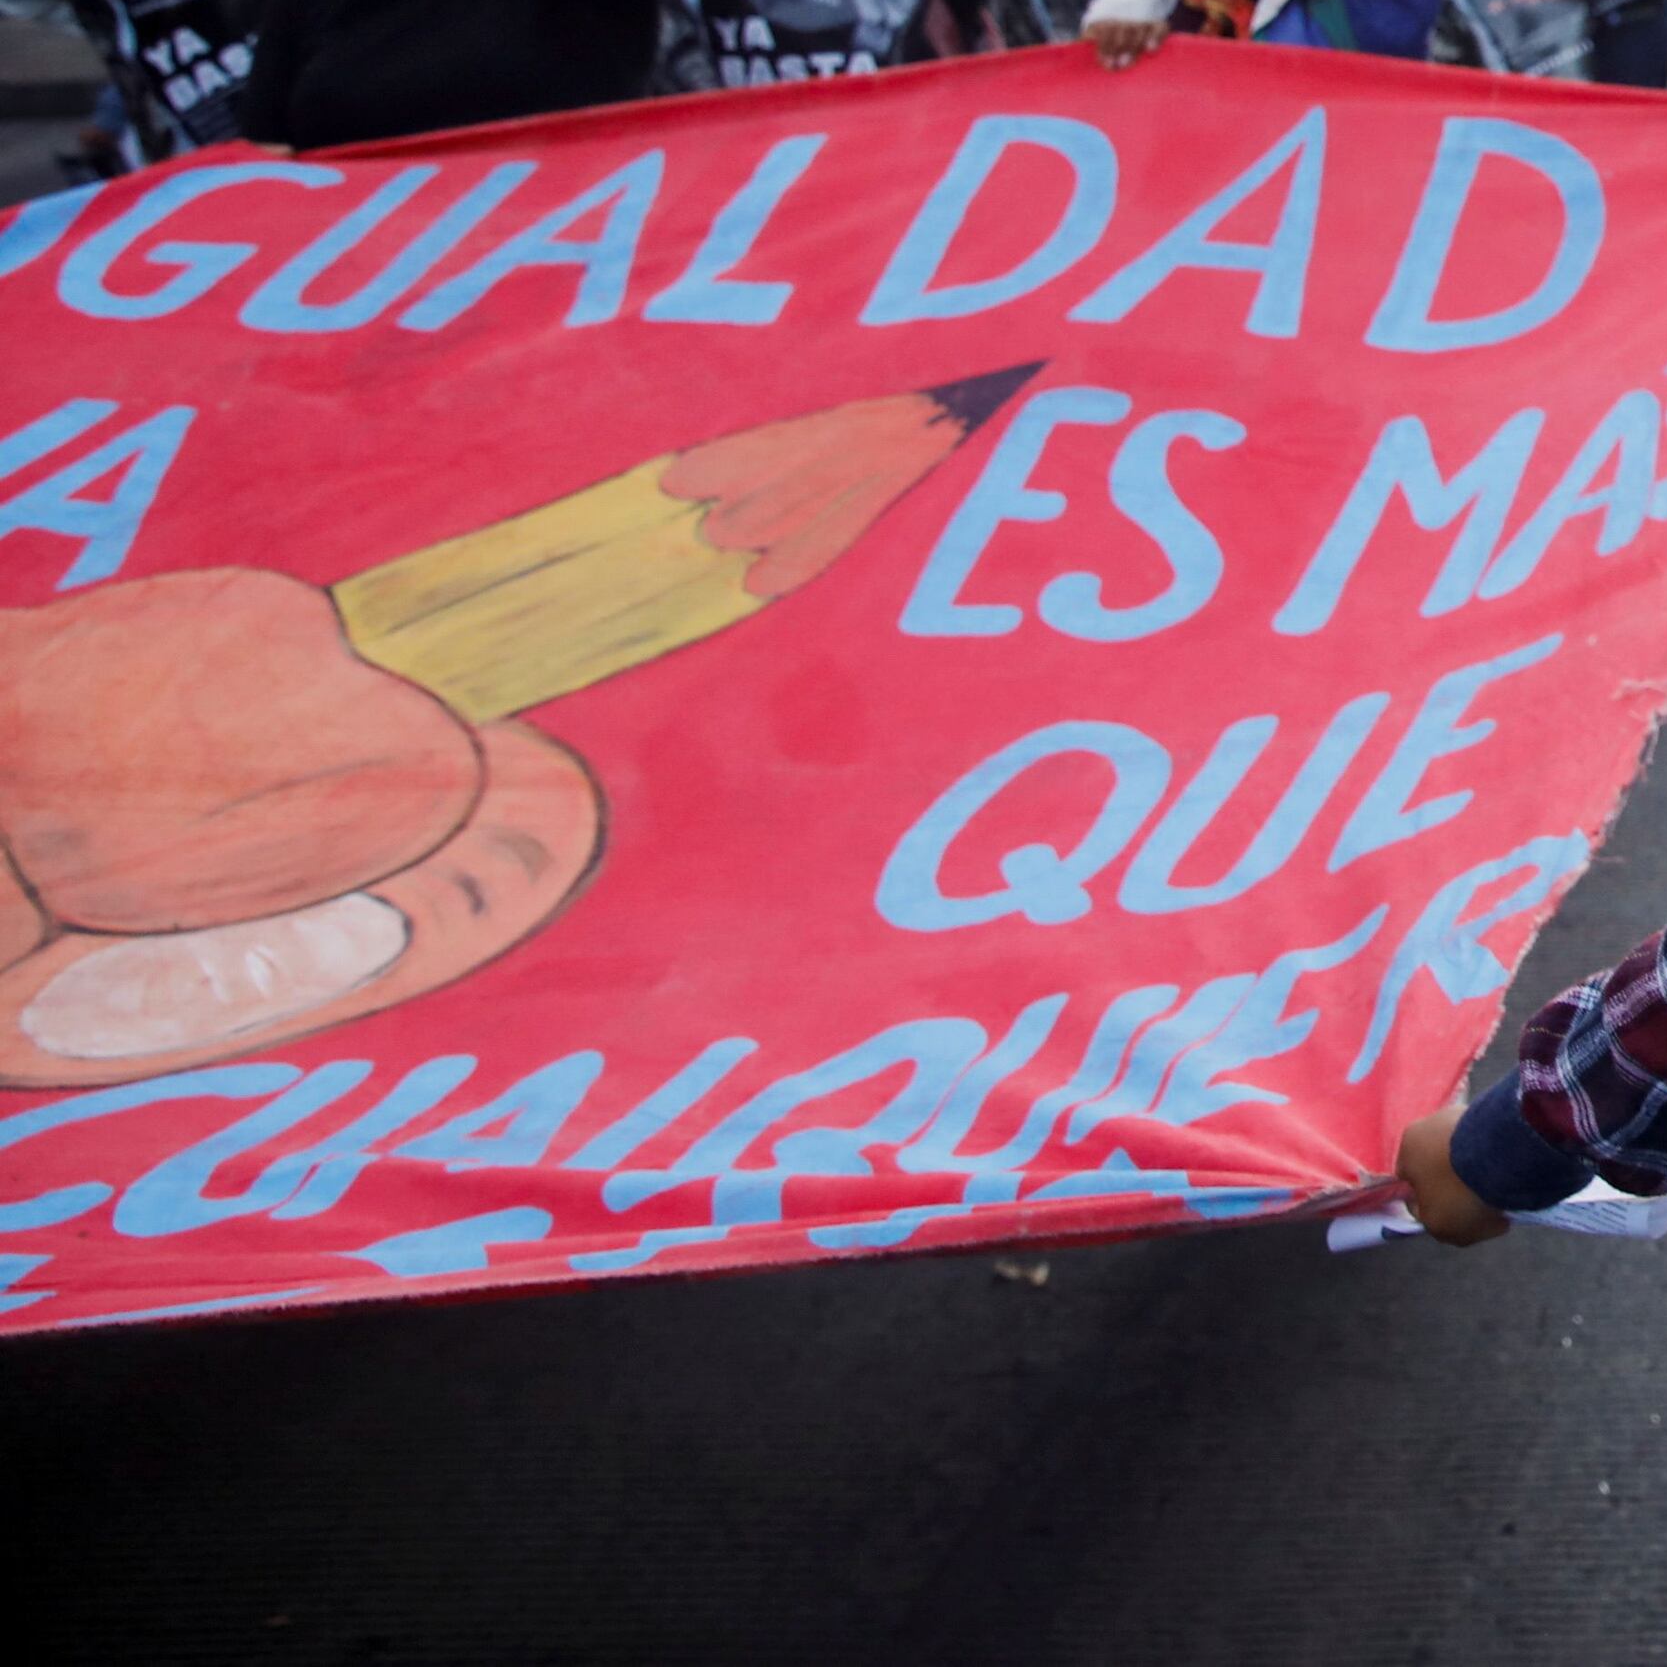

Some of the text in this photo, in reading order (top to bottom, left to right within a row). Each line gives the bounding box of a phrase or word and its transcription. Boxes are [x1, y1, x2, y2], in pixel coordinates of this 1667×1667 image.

[144, 26, 212, 76] YA
[713, 15, 777, 51] YA
[903, 386, 1247, 641] ES
[873, 632, 1565, 932] QUE
